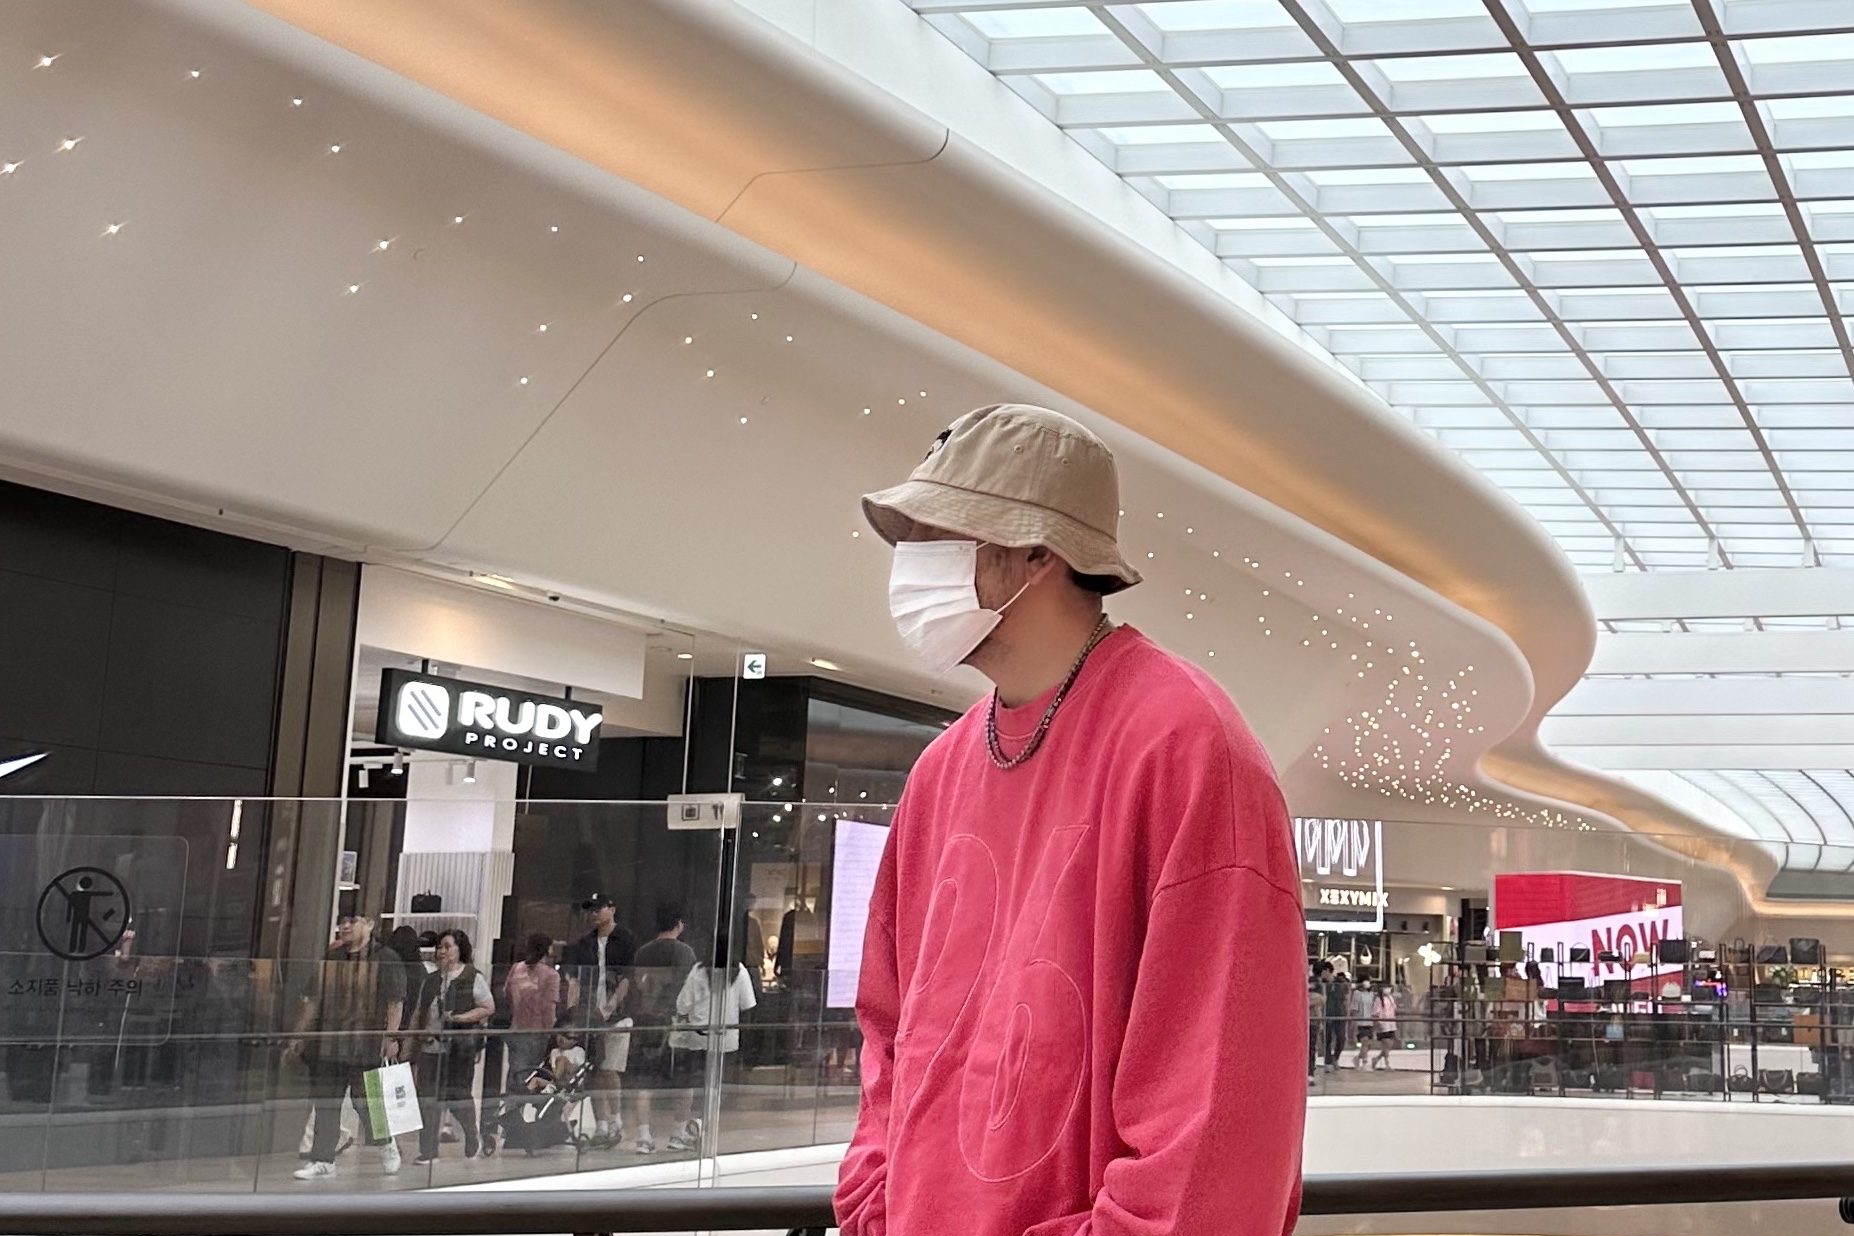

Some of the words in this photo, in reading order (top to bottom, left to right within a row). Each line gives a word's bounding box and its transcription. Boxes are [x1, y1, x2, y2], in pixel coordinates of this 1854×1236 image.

[458, 690, 604, 745] RUDY
[465, 732, 584, 761] PROJECT
[8, 978, 59, 997] 소지품
[67, 977, 100, 997] 낙하
[107, 977, 143, 998] 주의
